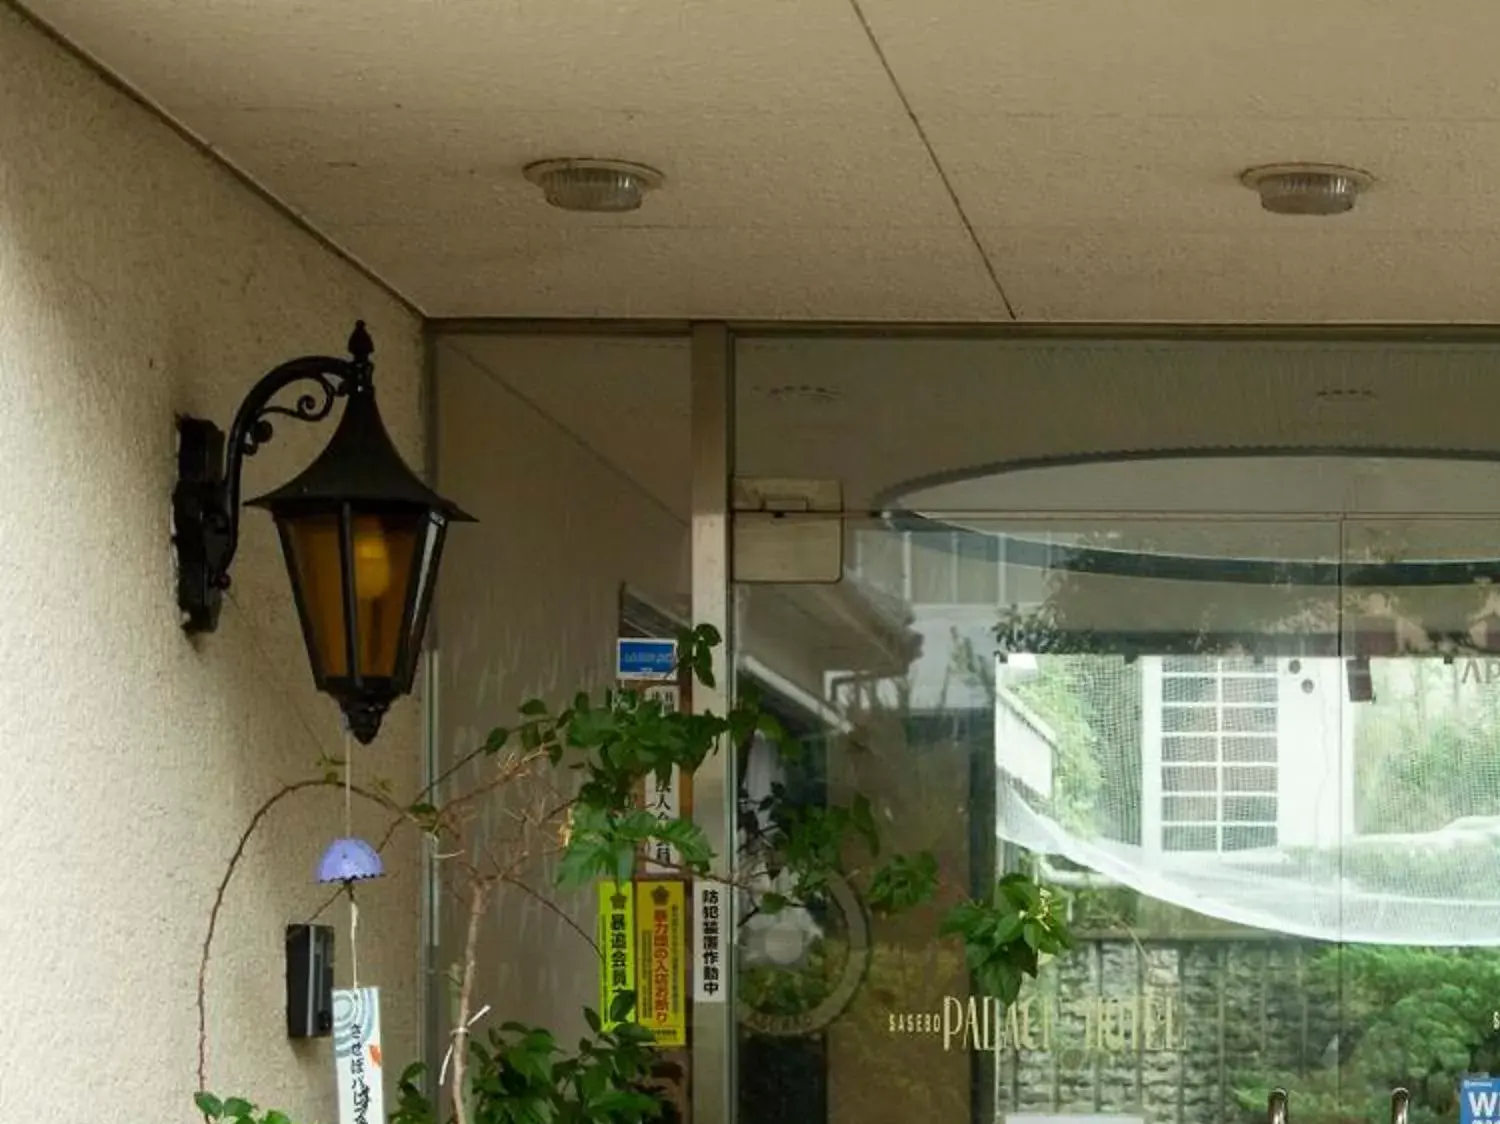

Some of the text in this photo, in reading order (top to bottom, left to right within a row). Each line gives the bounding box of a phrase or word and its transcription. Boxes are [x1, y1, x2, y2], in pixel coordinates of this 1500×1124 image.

[702, 889, 720, 996] 防犯装置作動中
[888, 1012, 941, 1033] SASEBO
[942, 994, 1053, 1051] PALACE
